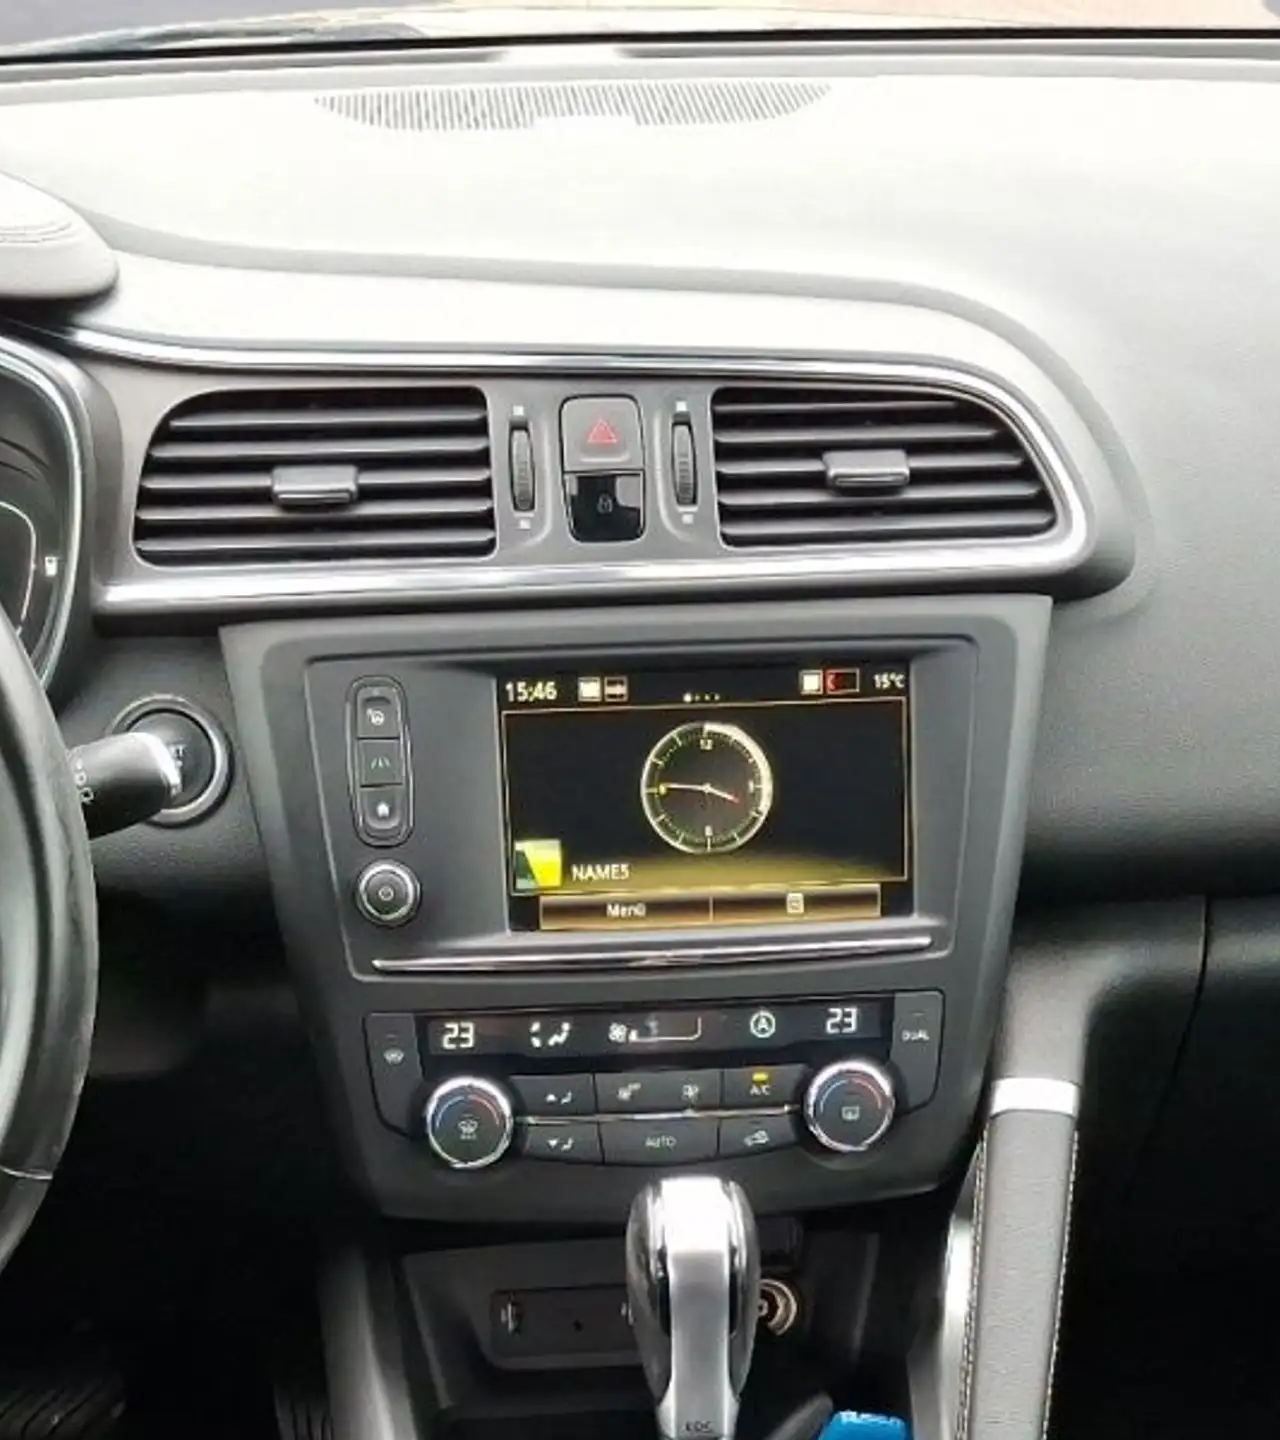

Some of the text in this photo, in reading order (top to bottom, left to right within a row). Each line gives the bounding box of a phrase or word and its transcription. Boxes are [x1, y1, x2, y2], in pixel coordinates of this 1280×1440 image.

[505, 680, 558, 702] 15:46
[825, 1007, 859, 1035] 23
[442, 1021, 475, 1050] 23
[645, 1134, 678, 1149] AUTO
